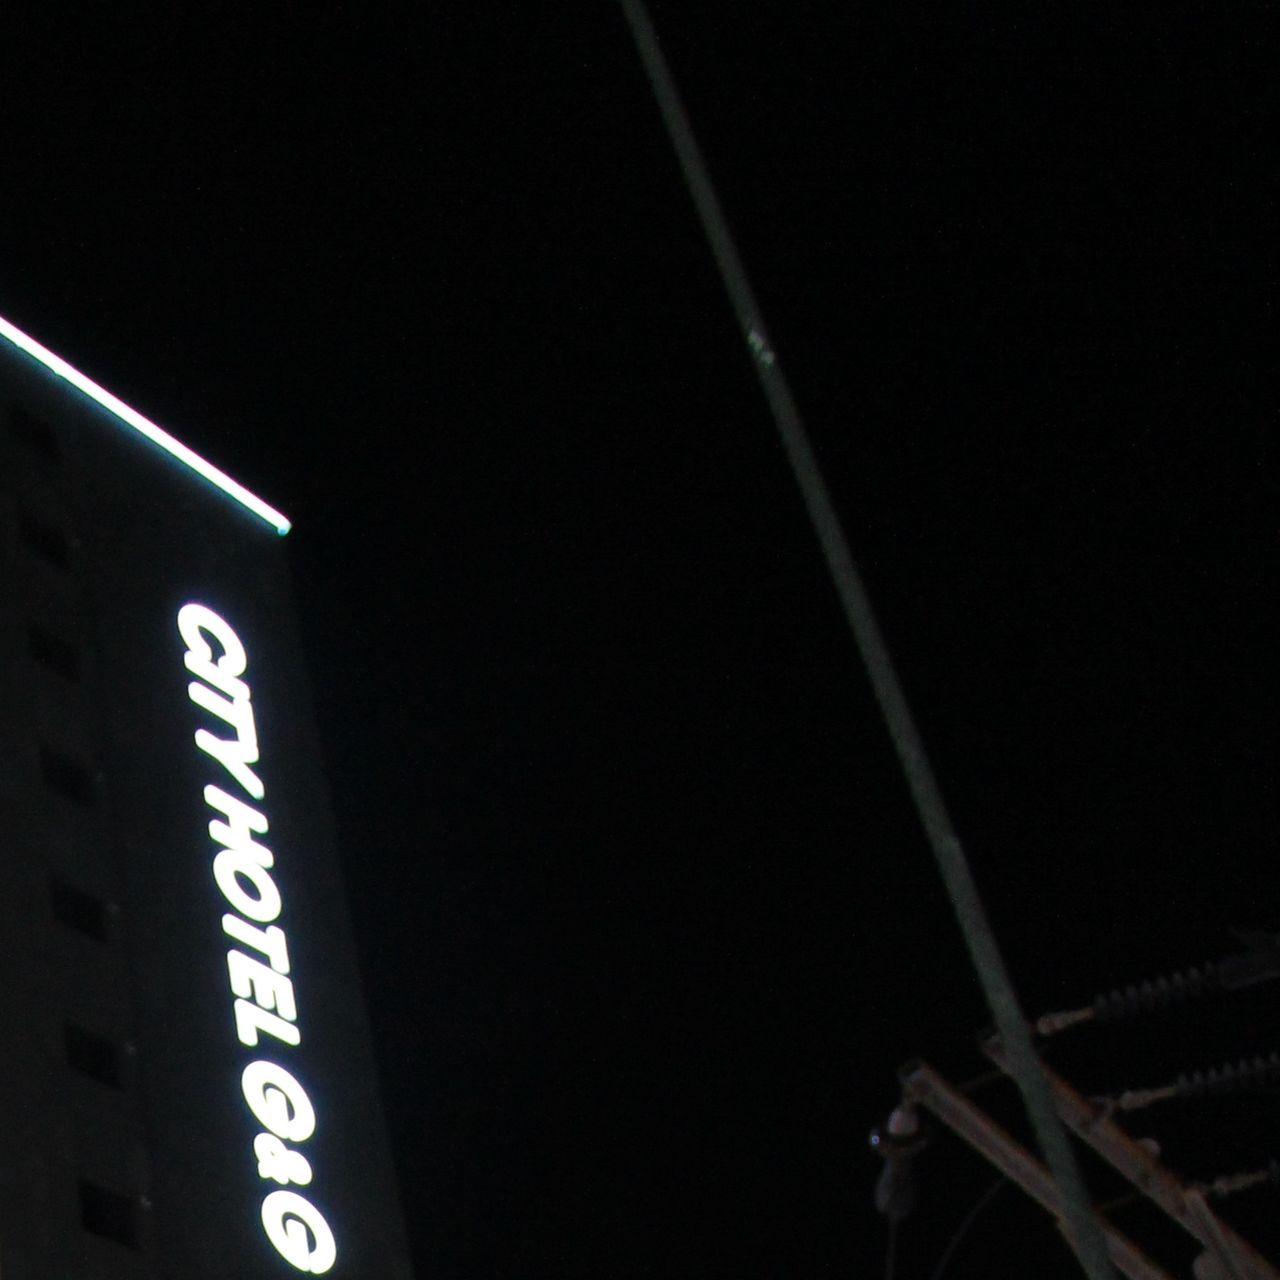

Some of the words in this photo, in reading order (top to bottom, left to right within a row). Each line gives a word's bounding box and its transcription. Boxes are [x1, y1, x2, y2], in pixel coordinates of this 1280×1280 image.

[177, 603, 265, 799] CITY
[203, 784, 301, 1046] HOTEL
[241, 1059, 337, 1274] G&G
